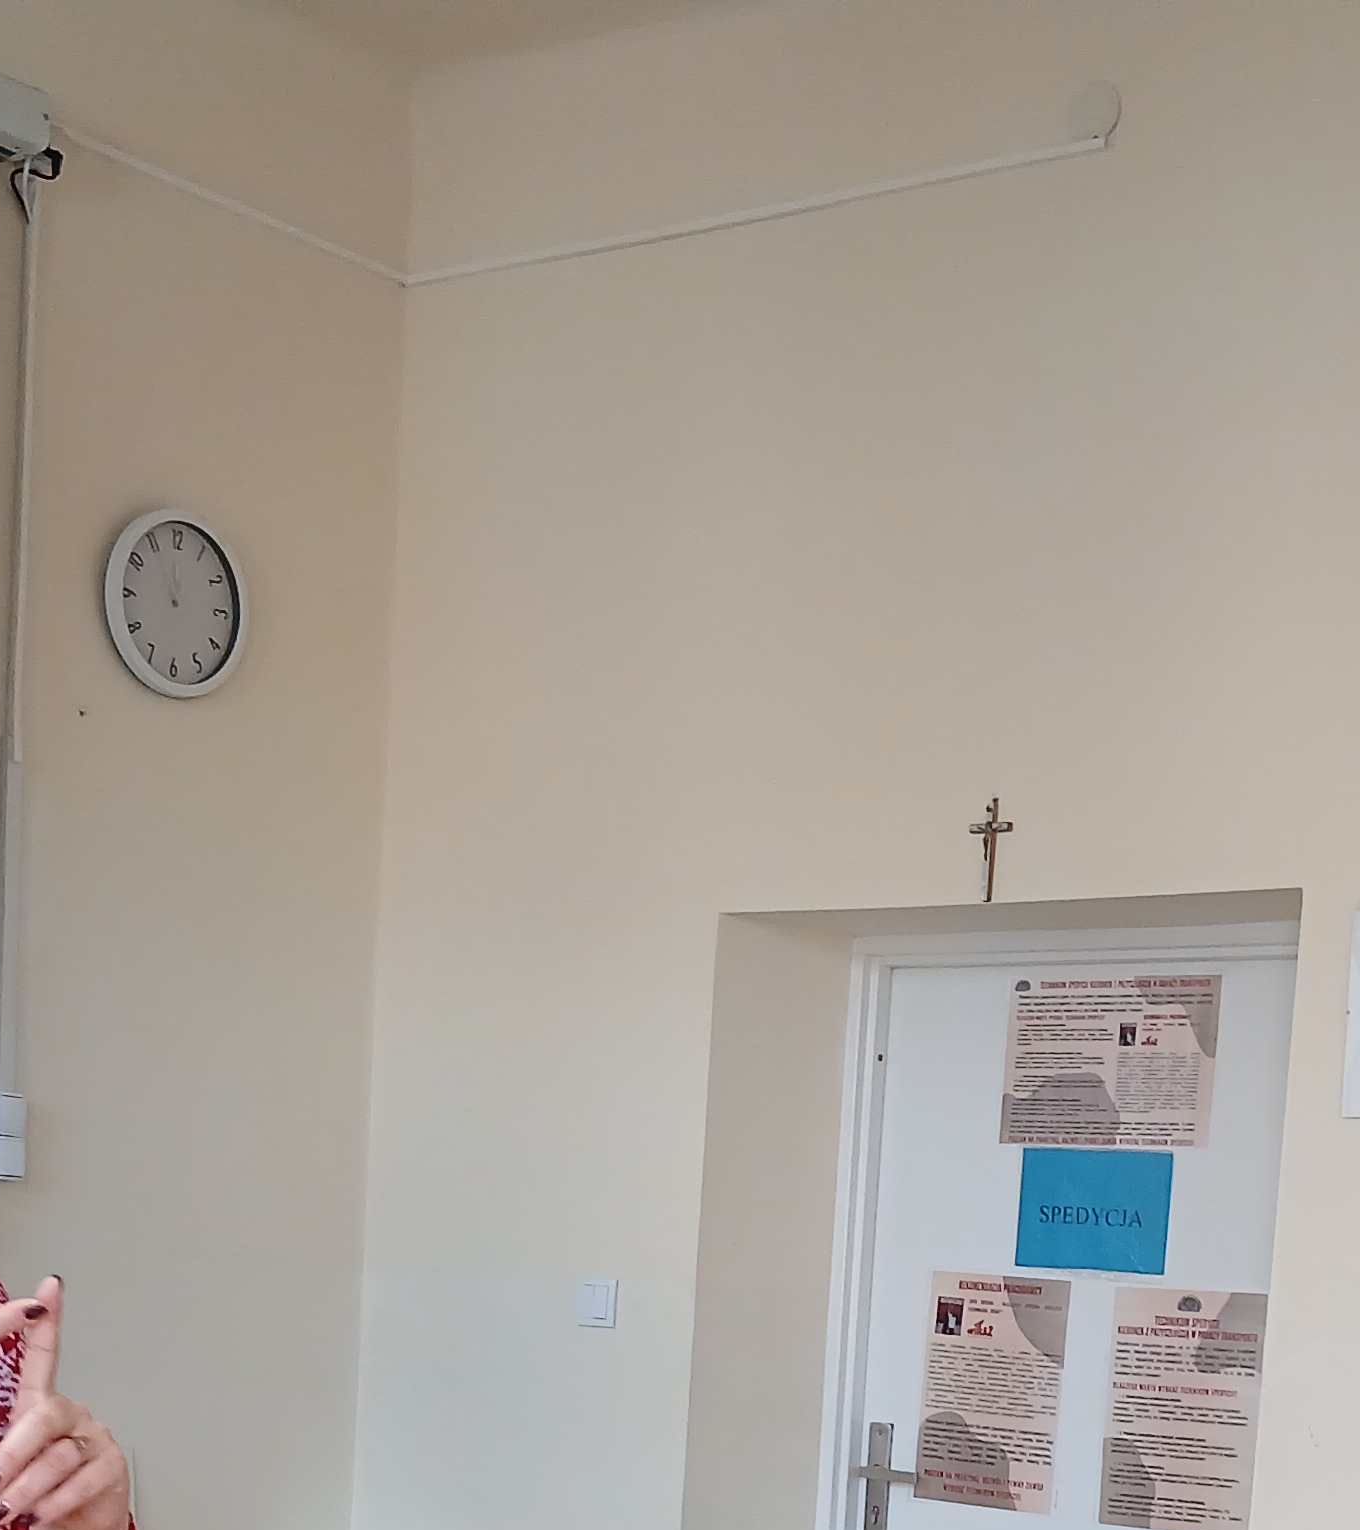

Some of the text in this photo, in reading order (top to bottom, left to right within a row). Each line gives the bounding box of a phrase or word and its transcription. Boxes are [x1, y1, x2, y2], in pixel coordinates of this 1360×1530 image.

[145, 532, 160, 553] 11
[172, 529, 184, 551] 12
[128, 551, 144, 572] 10
[208, 574, 223, 587] 2
[213, 608, 229, 620] 3
[127, 621, 142, 634] 8
[147, 642, 156, 664] 7
[208, 637, 221, 651] 4
[169, 657, 178, 678] 6
[191, 651, 203, 673] 5
[1039, 1204, 1142, 1229] SPEDYCJA
